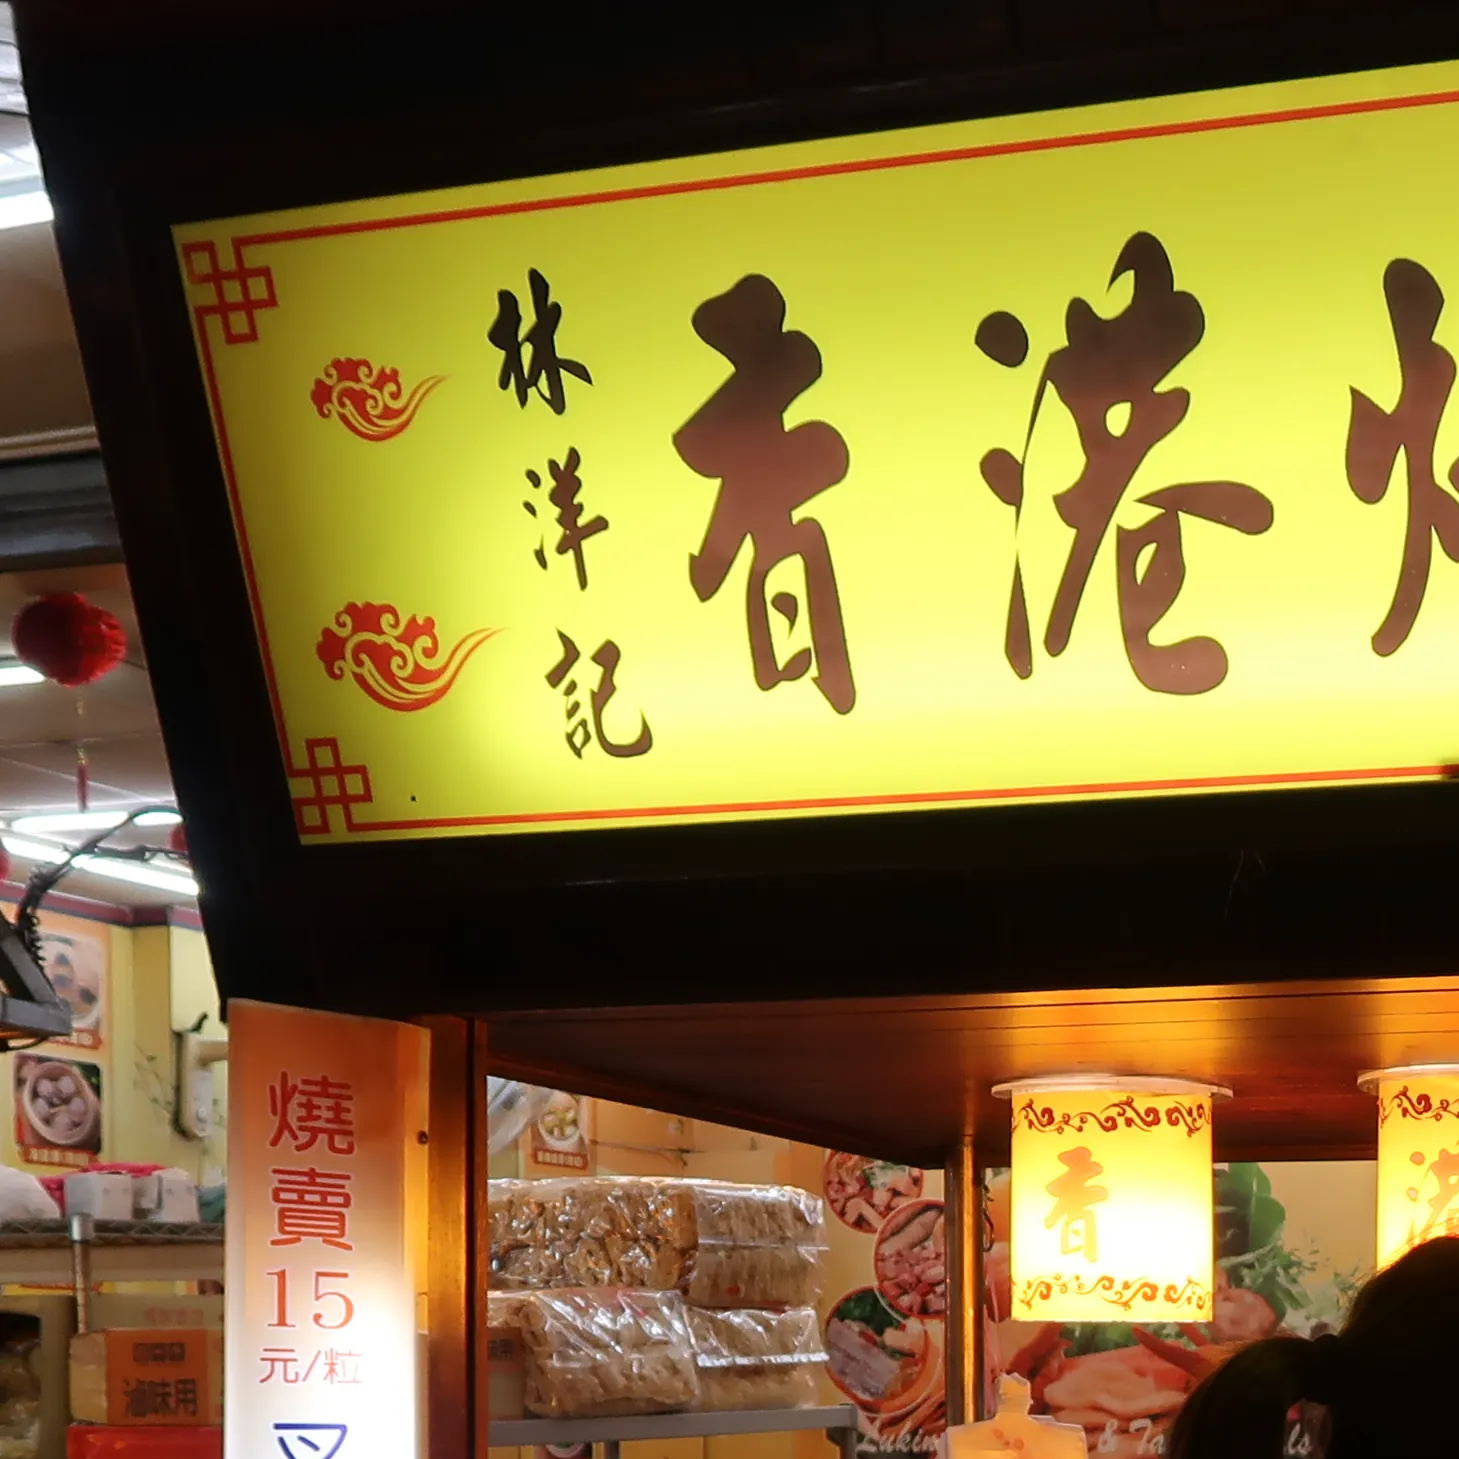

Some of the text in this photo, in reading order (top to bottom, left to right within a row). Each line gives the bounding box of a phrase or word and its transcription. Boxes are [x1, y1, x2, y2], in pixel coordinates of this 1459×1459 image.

[487, 267, 654, 759] 林洋記
[258, 1070, 363, 1385] 燒賣 15 元/粒
[1043, 1146, 1109, 1263] 香
